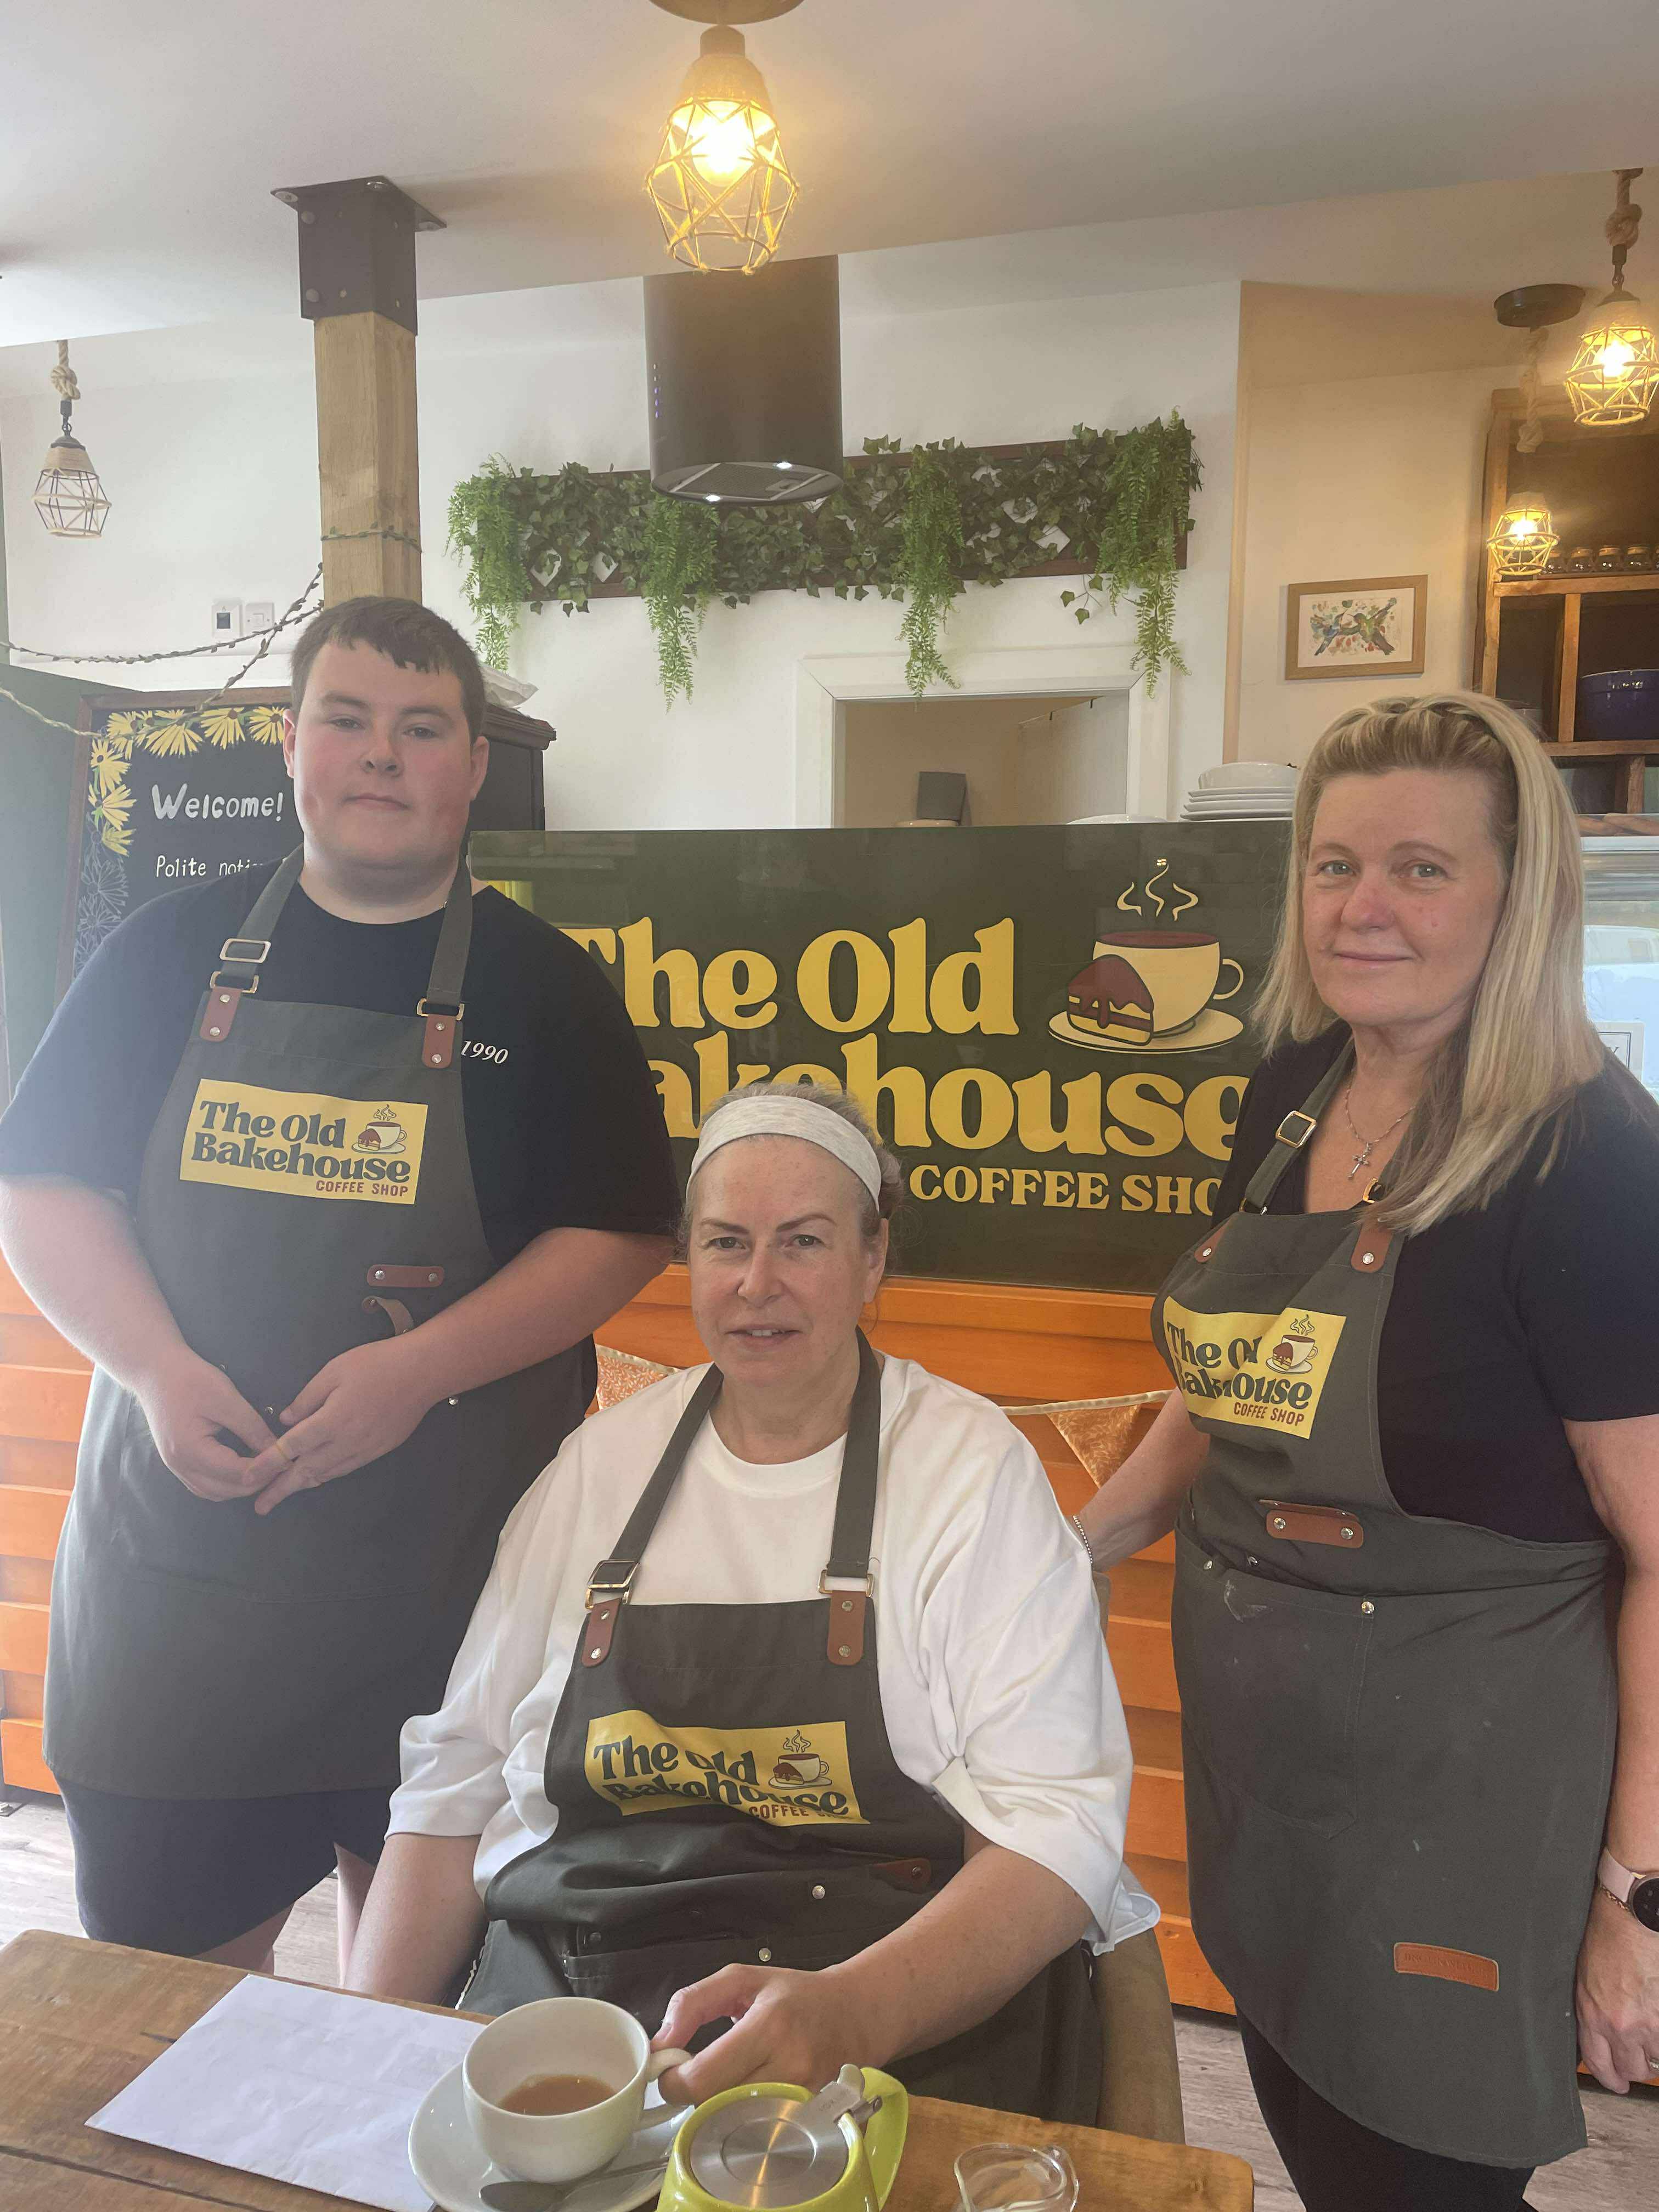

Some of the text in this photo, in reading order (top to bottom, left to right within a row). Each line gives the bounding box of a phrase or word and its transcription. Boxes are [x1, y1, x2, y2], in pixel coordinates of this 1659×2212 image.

[152, 783, 284, 822] Welcome!
[156, 855, 263, 878] Polite noti
[797, 917, 1019, 1036] Old
[461, 1040, 509, 1064] 1990
[647, 1030, 1250, 1161] akhouse
[199, 1101, 346, 1148] The Old
[191, 1132, 411, 1183] Bakehouse
[315, 1180, 408, 1197] COFFEE SHOP
[909, 1165, 1222, 1216] COFFEE SHO
[1167, 1321, 1222, 1368] The
[1234, 1402, 1304, 1426] COFFEE SHOP
[593, 1735, 679, 1780] The
[749, 1804, 809, 1819] COFFEE
